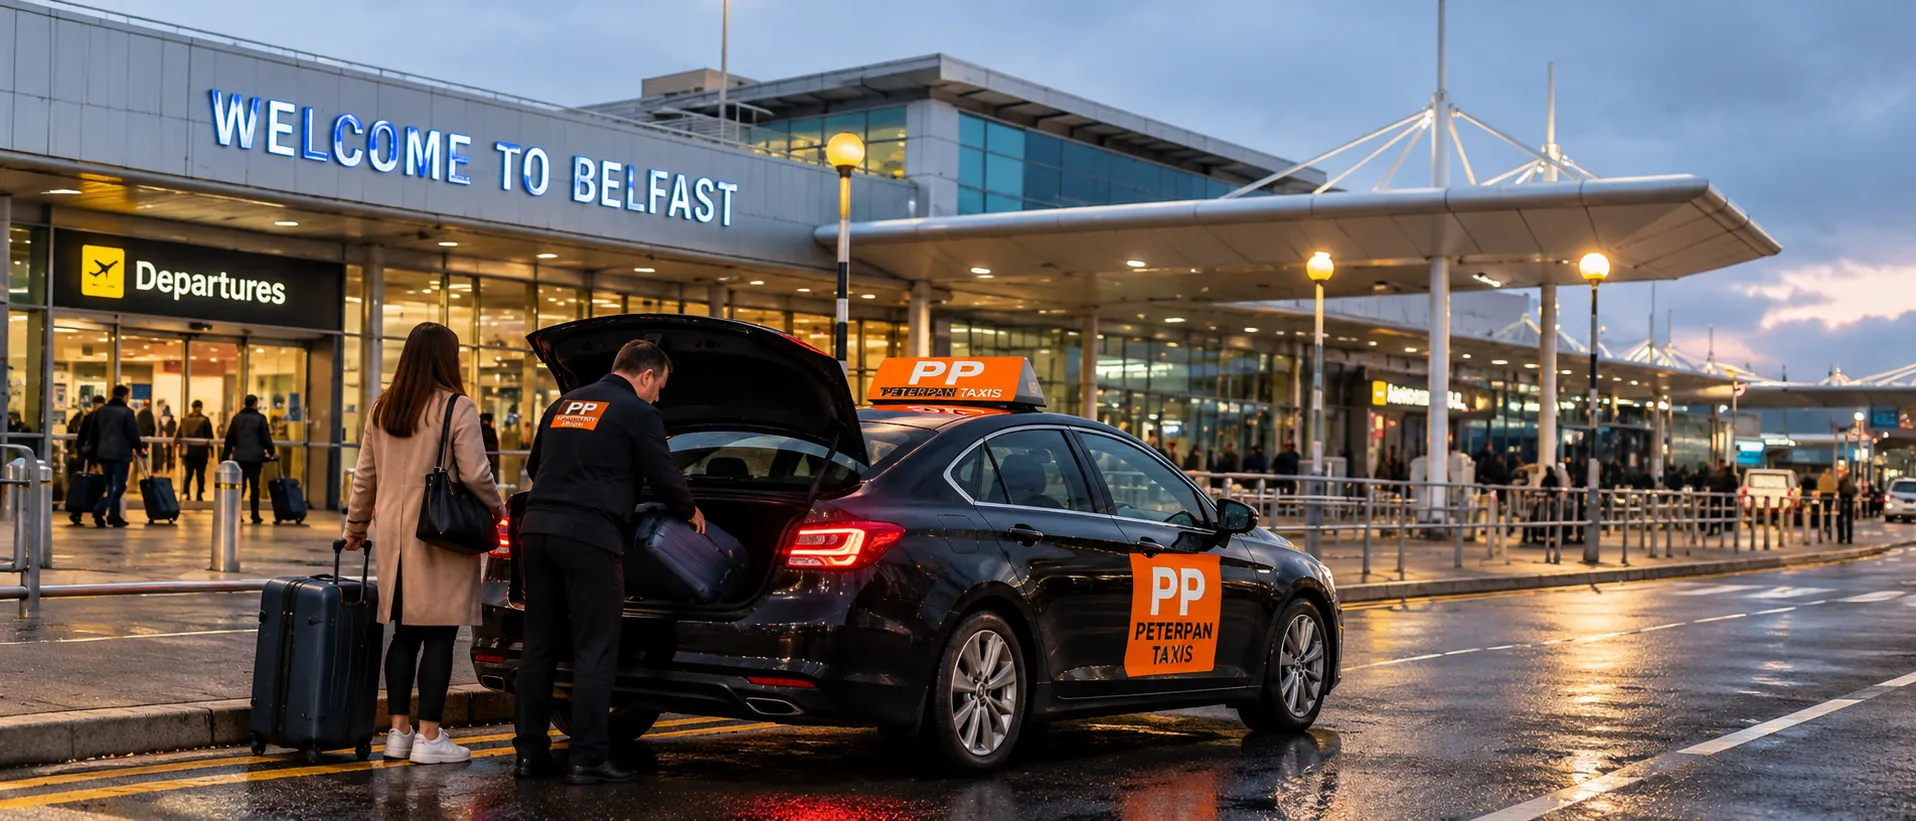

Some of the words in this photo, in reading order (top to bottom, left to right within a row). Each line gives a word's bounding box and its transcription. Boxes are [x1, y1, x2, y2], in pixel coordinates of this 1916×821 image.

[210, 89, 472, 185] WELCOME
[495, 141, 550, 196] TO
[573, 155, 738, 227] BELFAST
[136, 260, 286, 305] Departures
[908, 360, 985, 386] PP
[880, 386, 957, 397] PETERPAN
[960, 388, 1003, 398] TAXIS
[565, 401, 598, 415] PP
[1150, 566, 1206, 616] PP
[1135, 622, 1213, 641] PETERPAN
[1152, 645, 1194, 665] TAXIS
